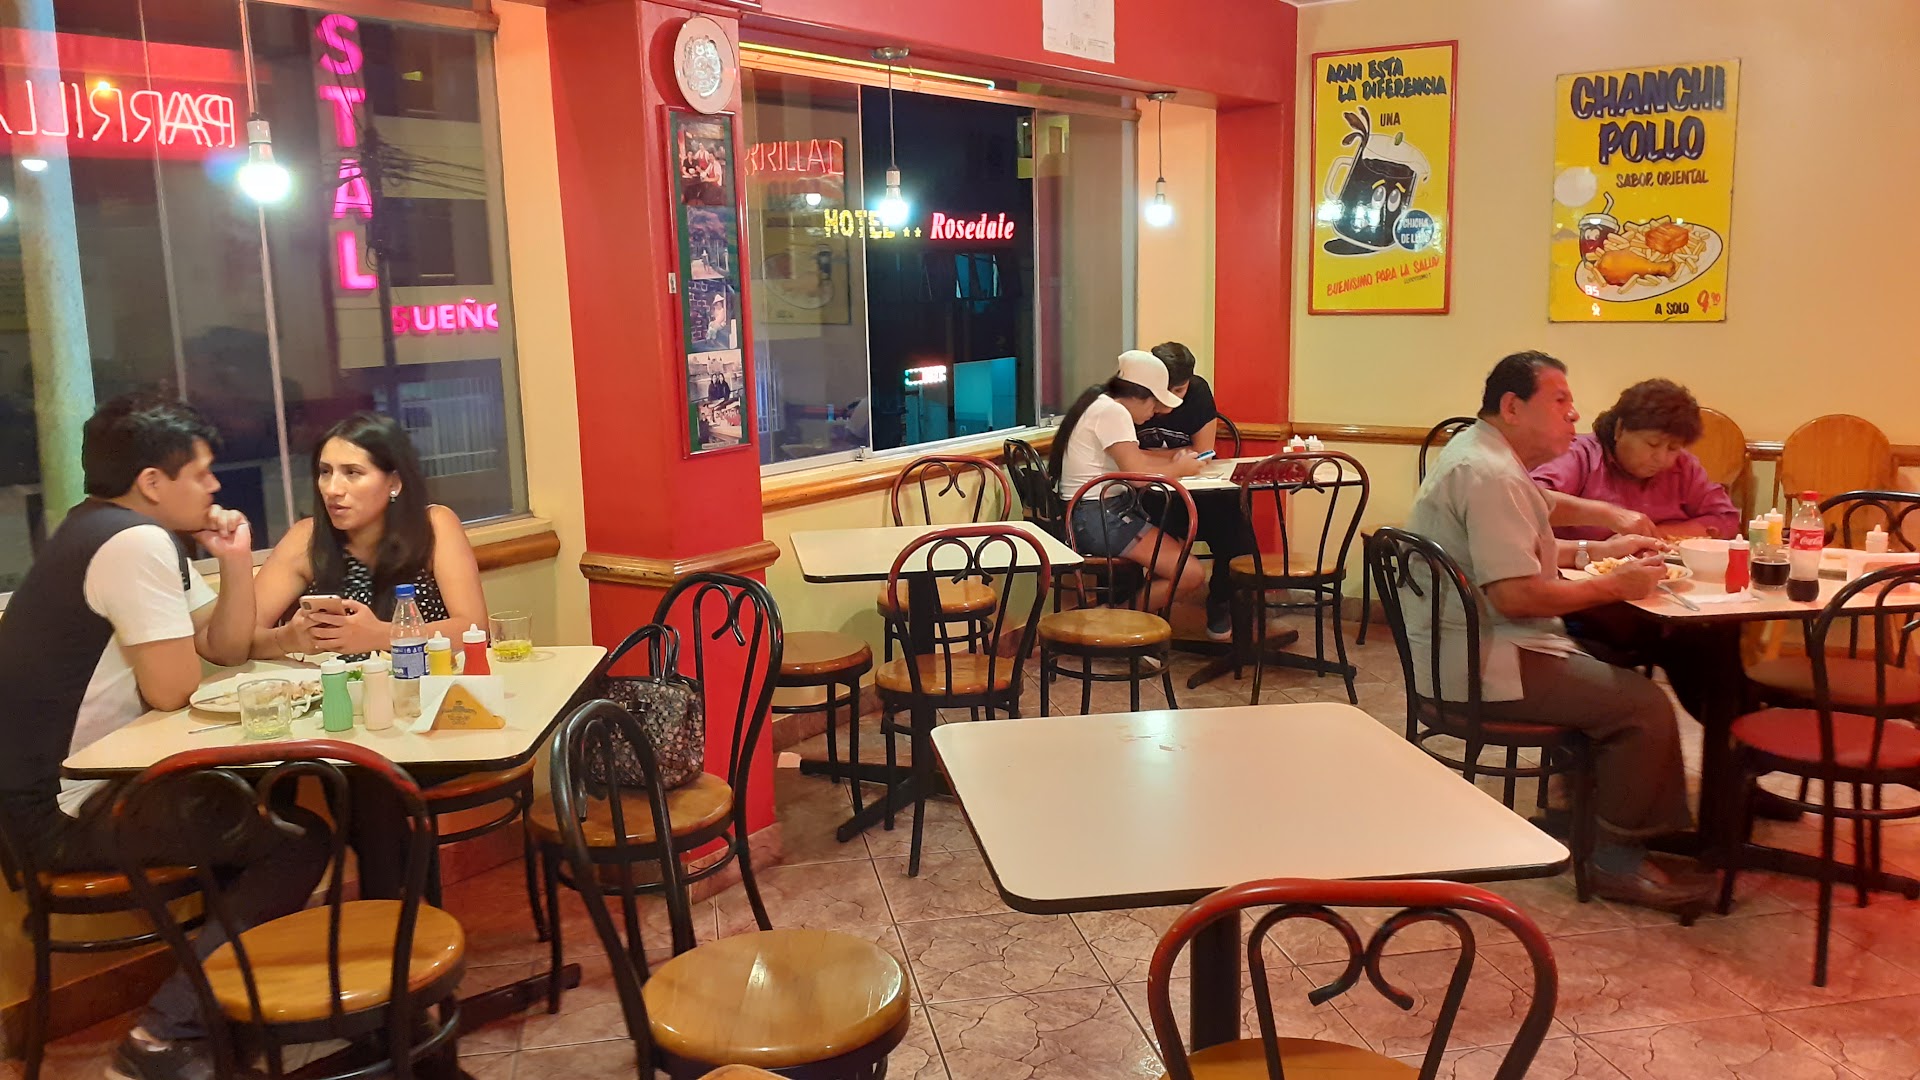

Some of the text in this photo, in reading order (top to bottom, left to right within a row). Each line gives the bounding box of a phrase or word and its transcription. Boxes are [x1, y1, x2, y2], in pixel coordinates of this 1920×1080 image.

[1326, 56, 1404, 84] AQUI ESTA
[1338, 75, 1447, 103] LA DIFERENCIA
[1571, 65, 1725, 119] CHANCHI
[1380, 112, 1401, 127] UNA
[1599, 115, 1705, 165] POLLO
[1616, 168, 1709, 188] SABOR ORIENTAL
[930, 212, 1015, 240] Rosedale
[1400, 233, 1410, 244] DE
[1376, 268, 1398, 283] PARA
[1400, 263, 1411, 277] LA
[1655, 303, 1663, 315] A
[1667, 302, 1690, 315] SOLO
